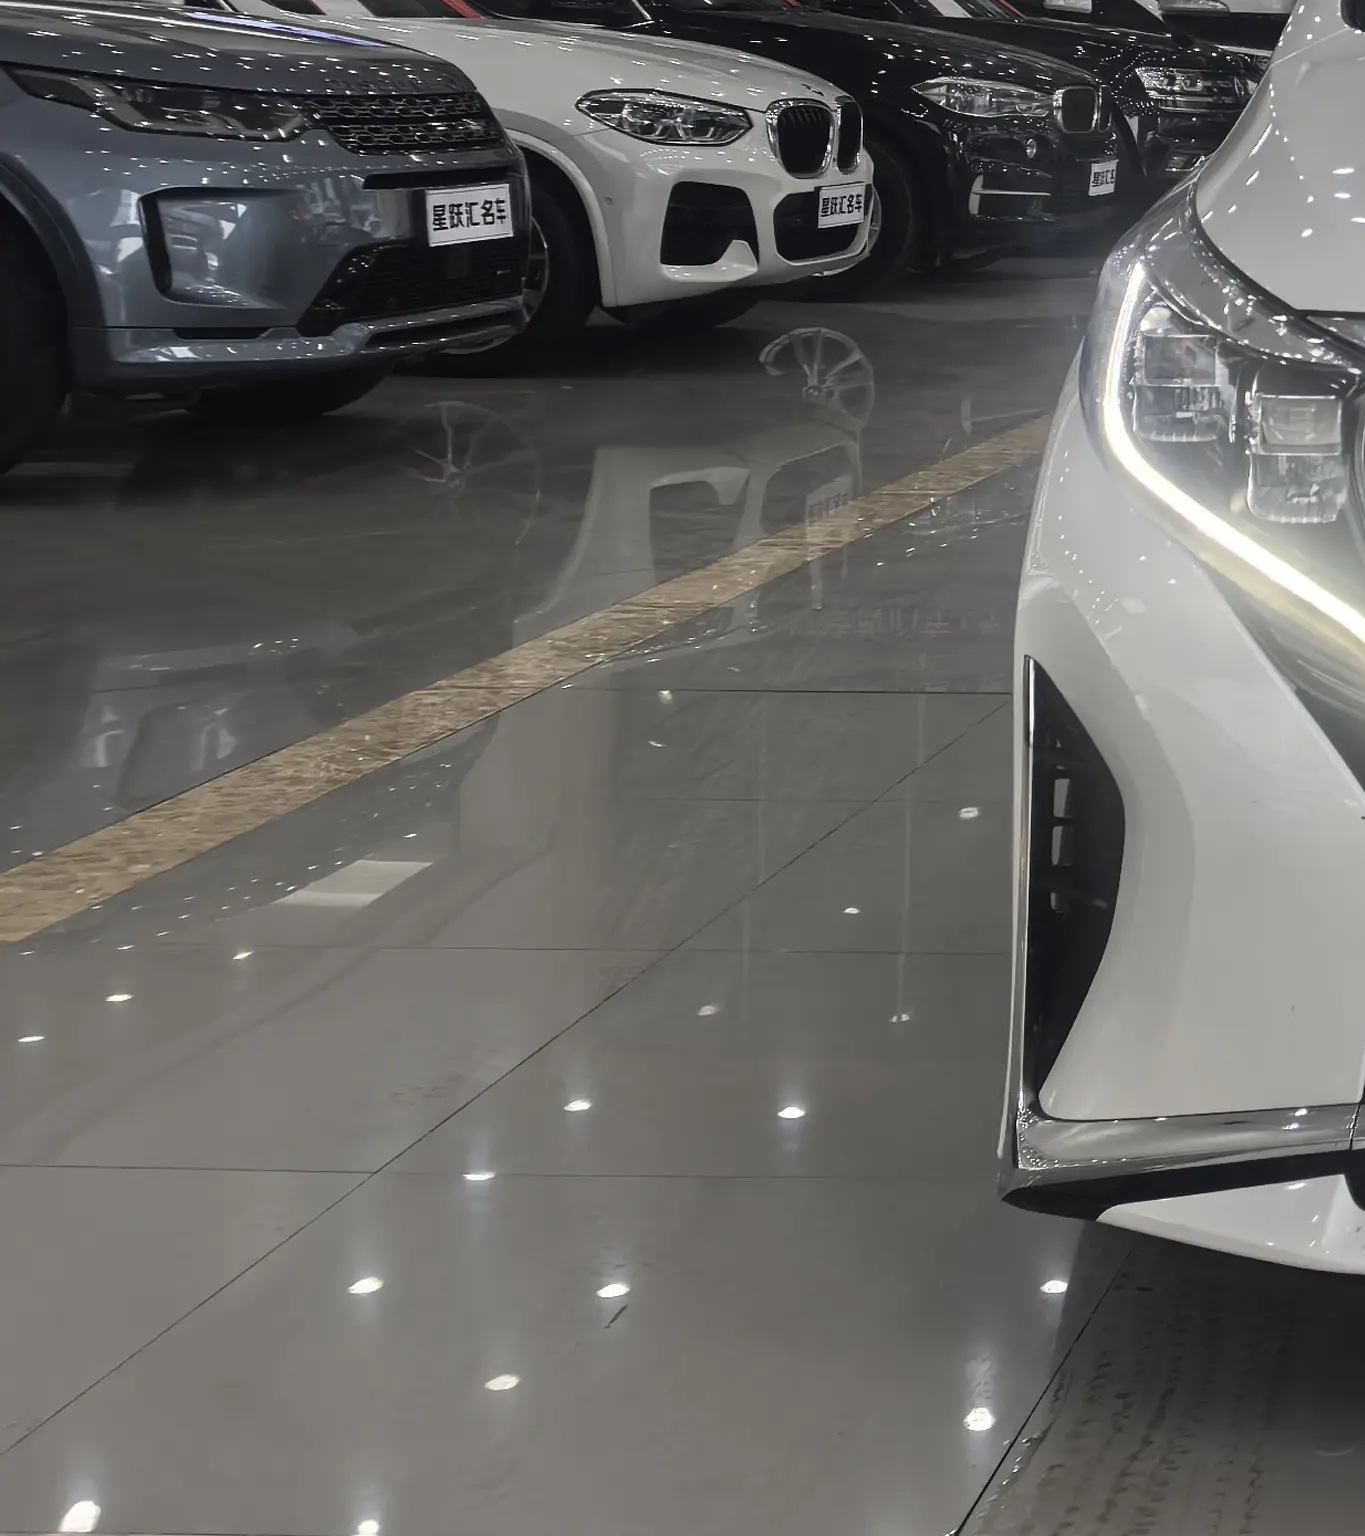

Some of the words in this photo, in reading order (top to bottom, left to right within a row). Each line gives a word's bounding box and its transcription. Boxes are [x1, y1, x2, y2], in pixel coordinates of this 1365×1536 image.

[432, 198, 506, 231] 星跃汇名车
